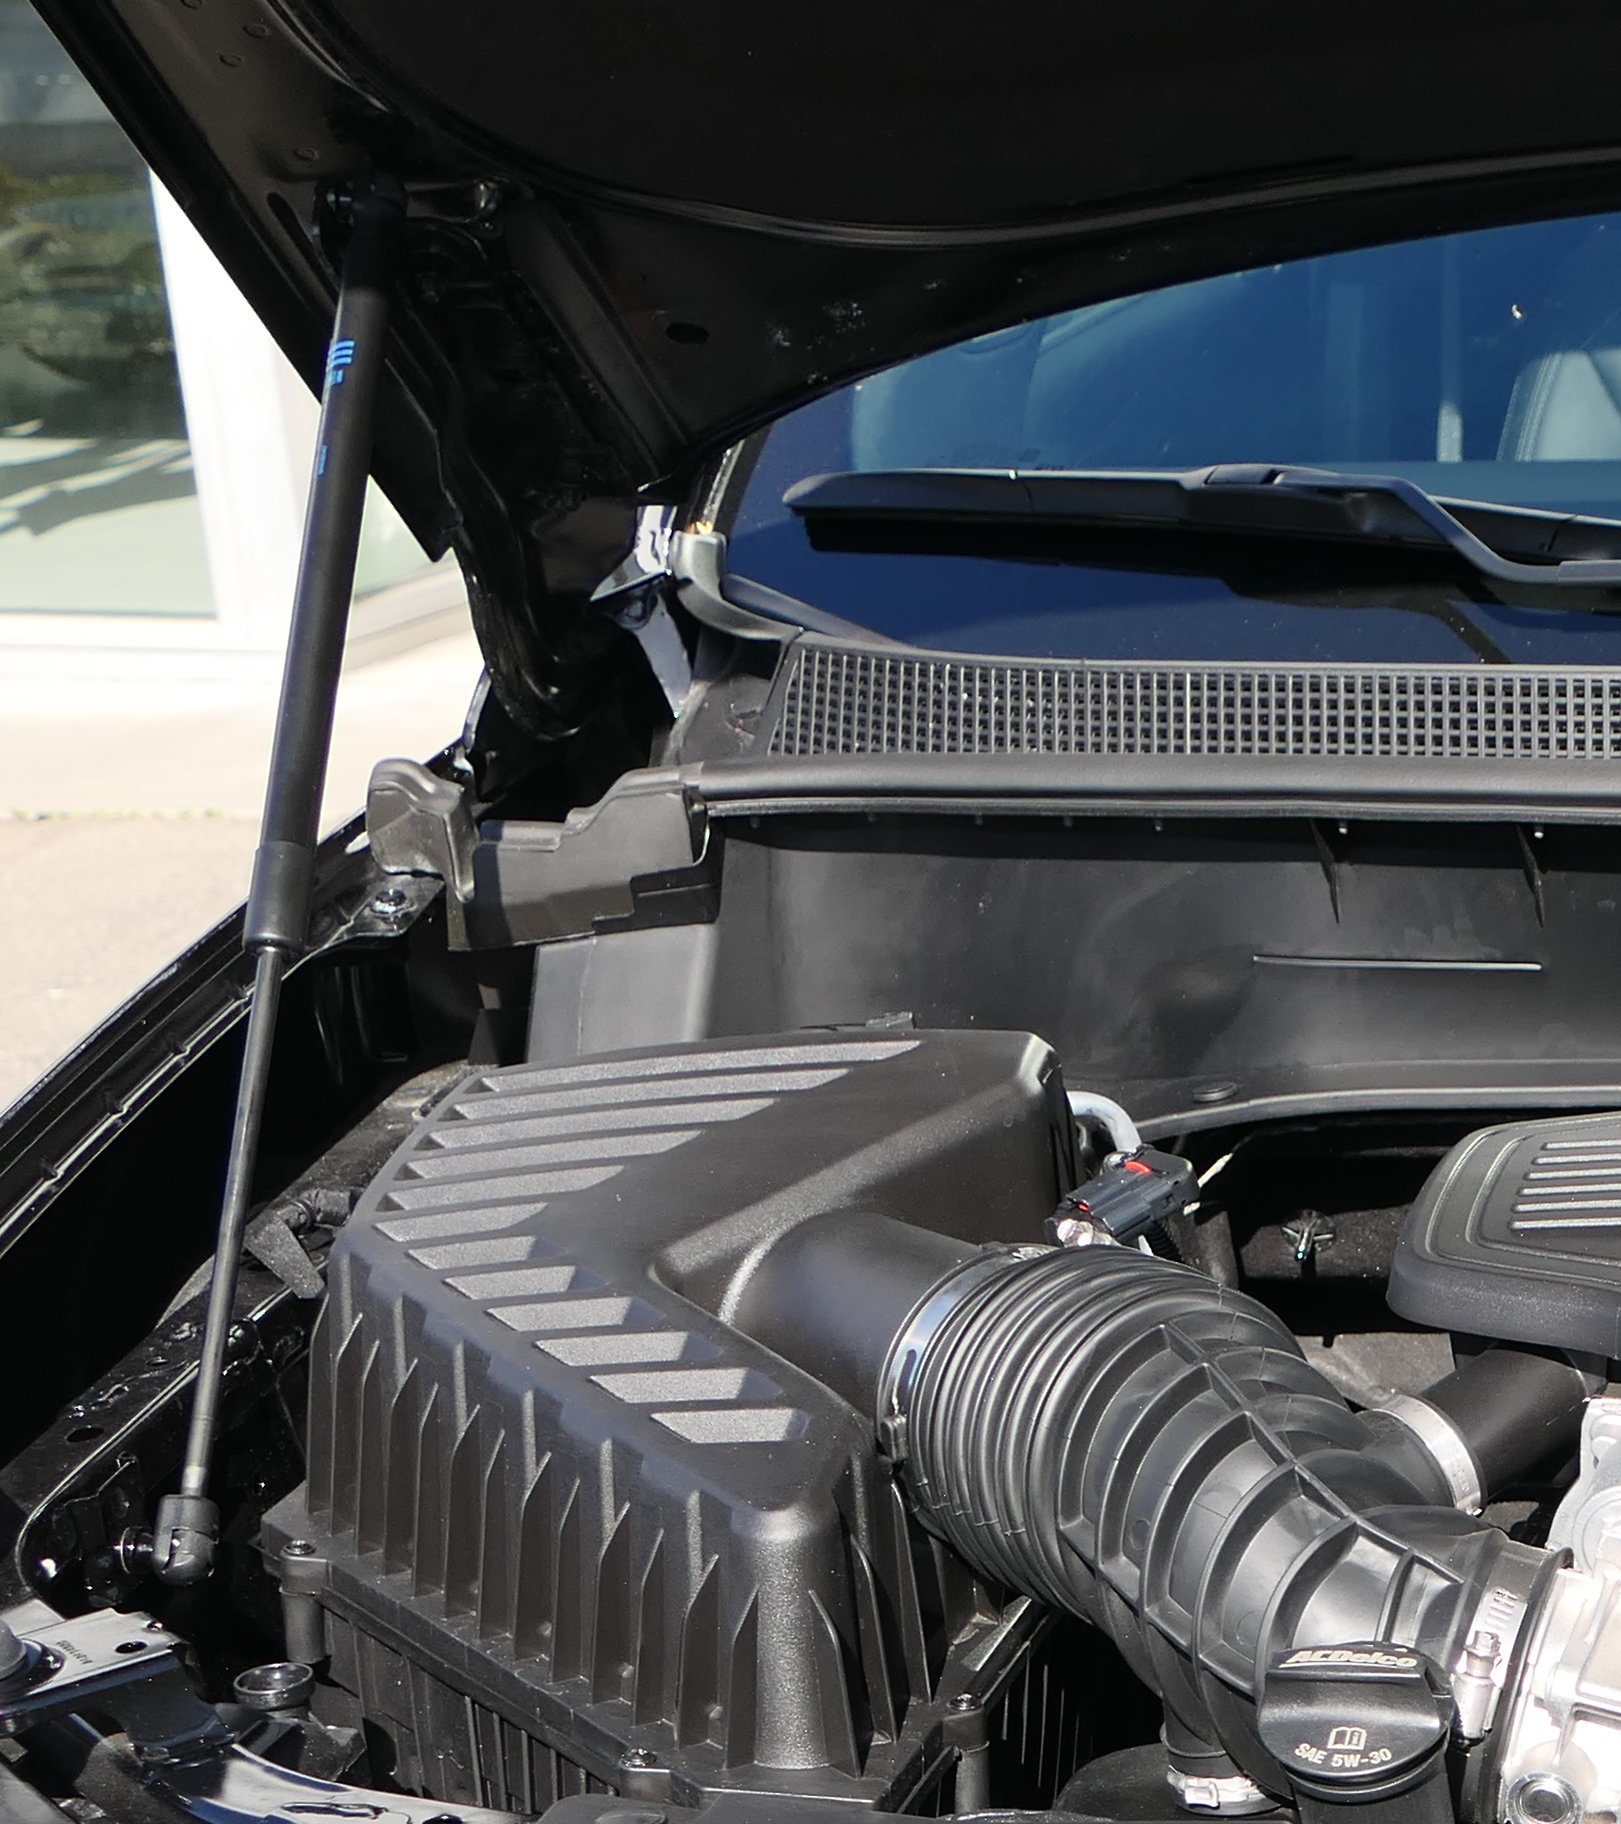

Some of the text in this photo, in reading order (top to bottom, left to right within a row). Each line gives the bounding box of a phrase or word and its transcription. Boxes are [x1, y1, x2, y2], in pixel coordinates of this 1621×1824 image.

[1285, 1650, 1418, 1668] ACDelco
[1294, 1743, 1393, 1768] SAE 5W-30
